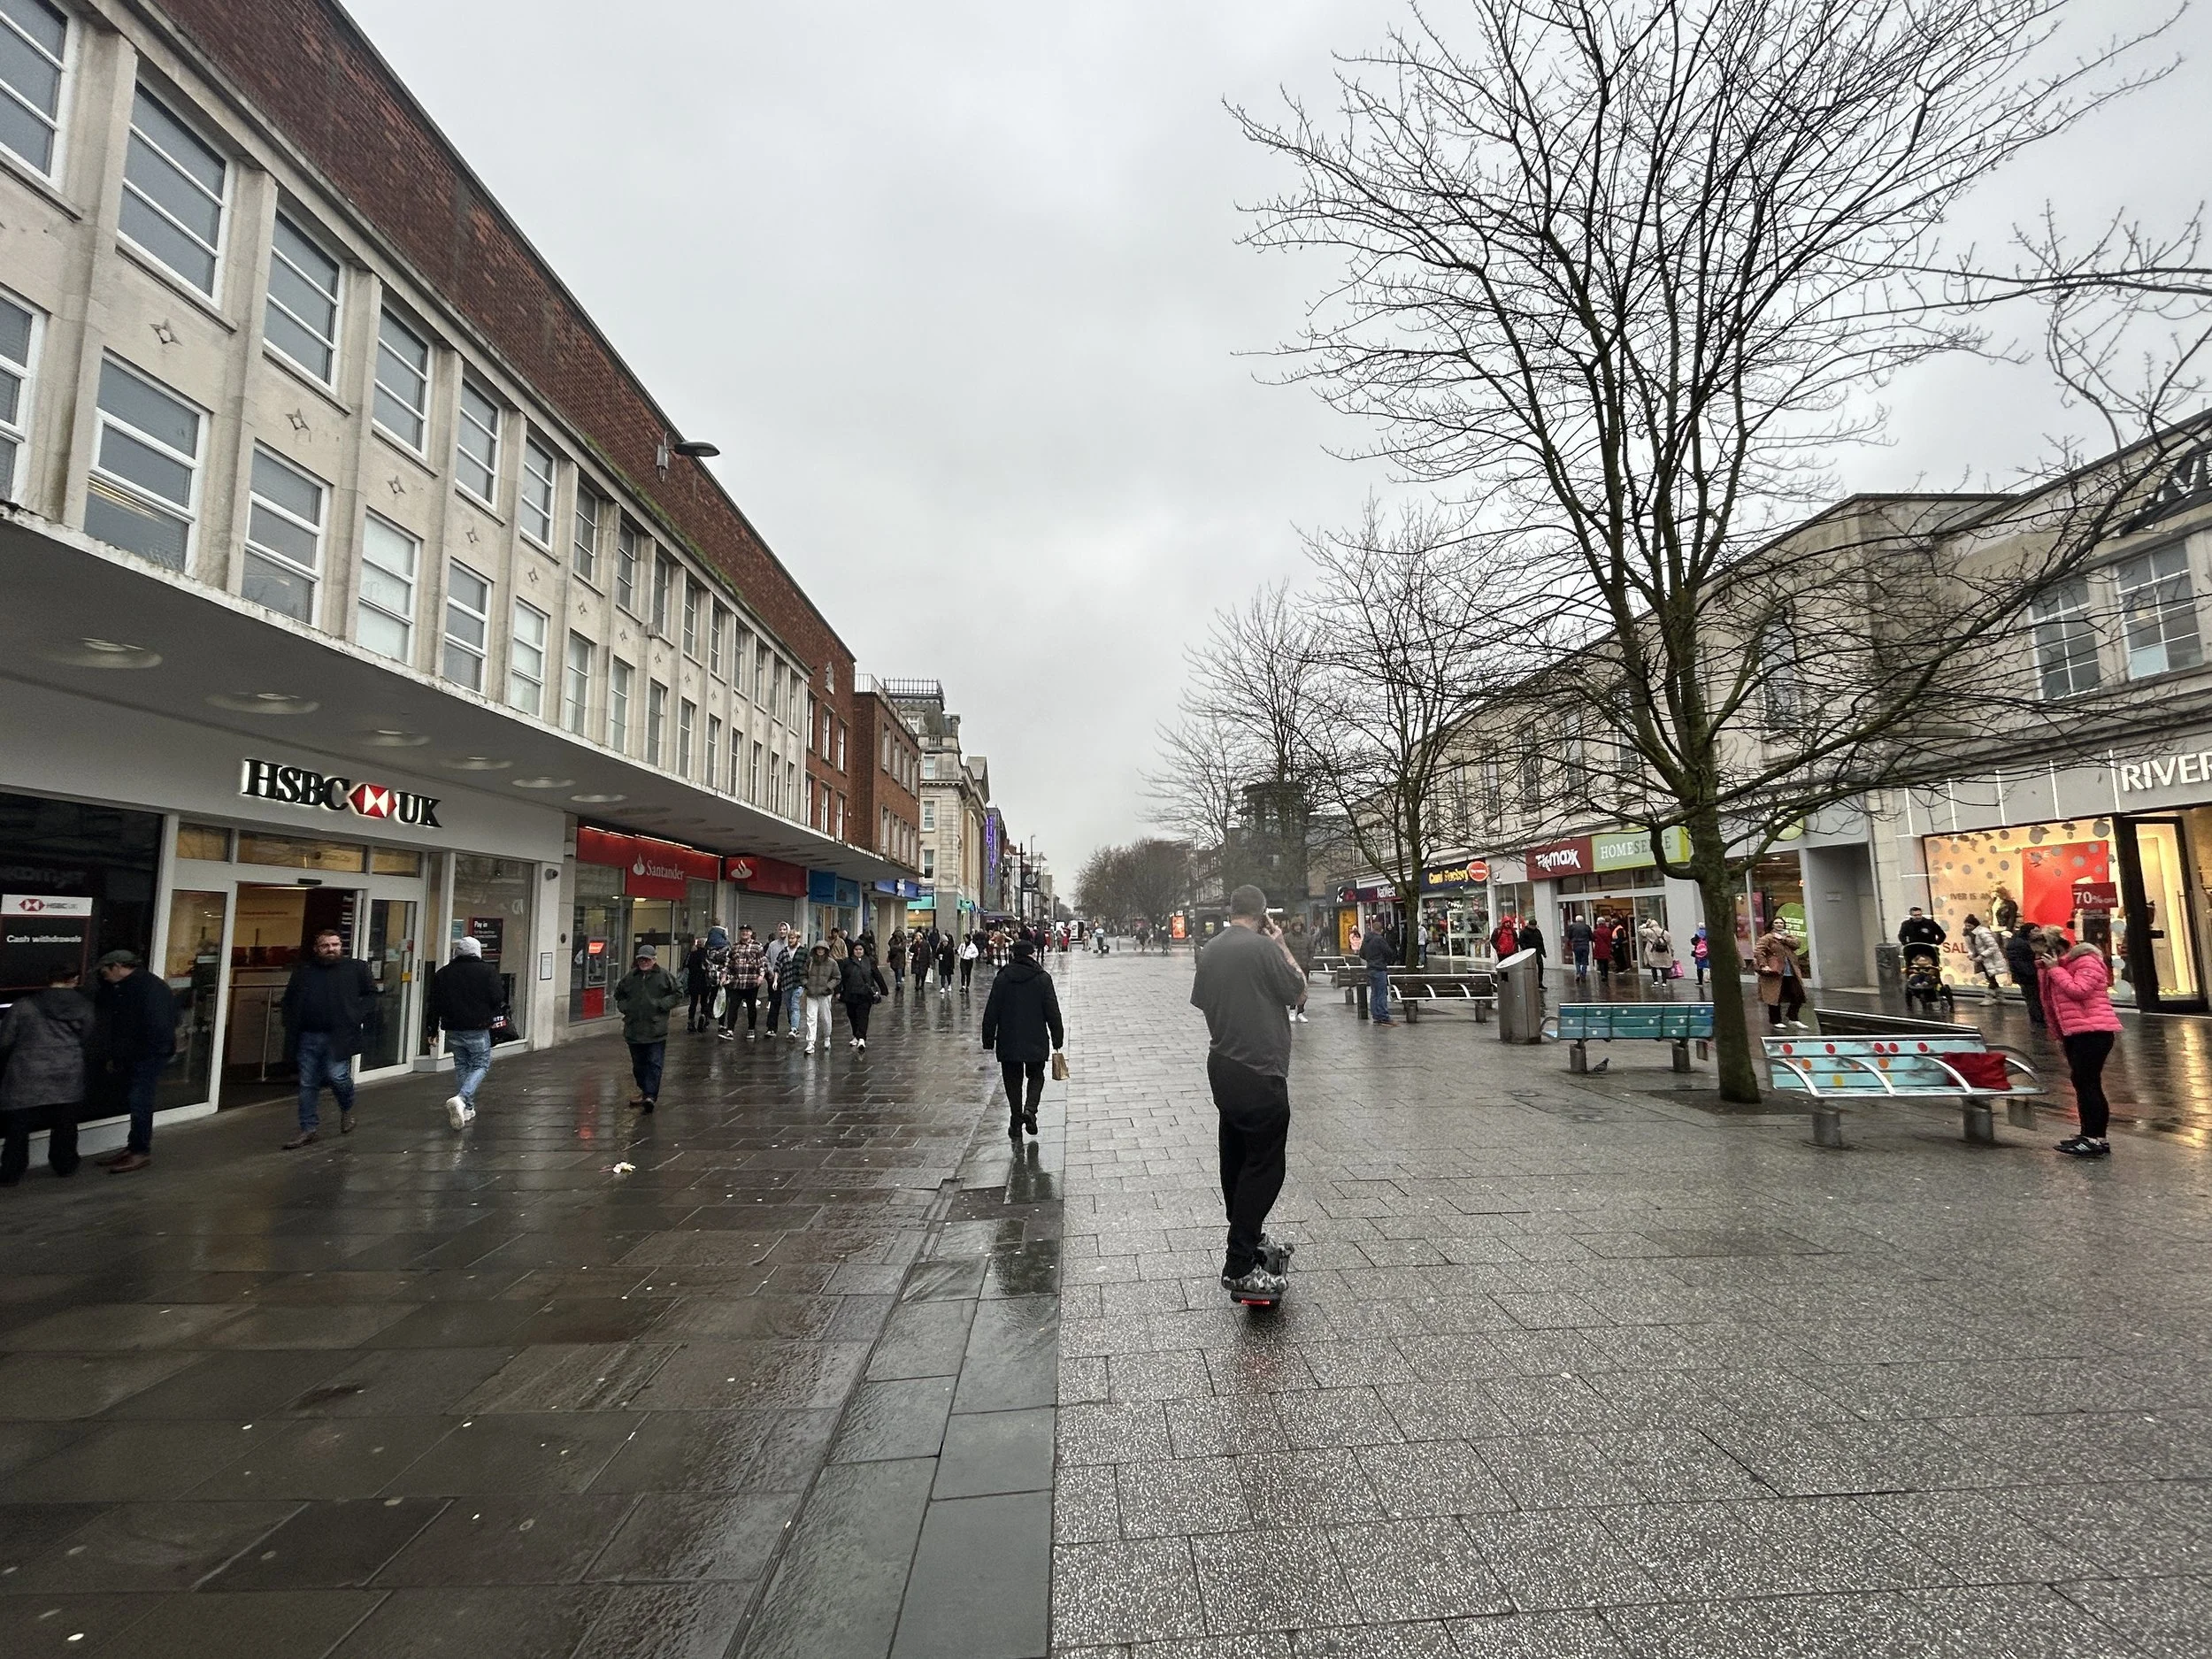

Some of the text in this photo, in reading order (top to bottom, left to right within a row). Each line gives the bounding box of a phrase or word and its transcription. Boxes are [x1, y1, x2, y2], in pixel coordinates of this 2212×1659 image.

[2120, 751, 2212, 792] RIVER
[242, 757, 442, 828] HSBC UK
[1600, 835, 1671, 859] HOMESEE
[646, 859, 685, 880] Santander
[1428, 868, 1469, 885] Card Factory
[1377, 885, 1396, 899] NatWest
[473, 920, 482, 929] Pay
[6, 934, 82, 943] Cash withdrawals
